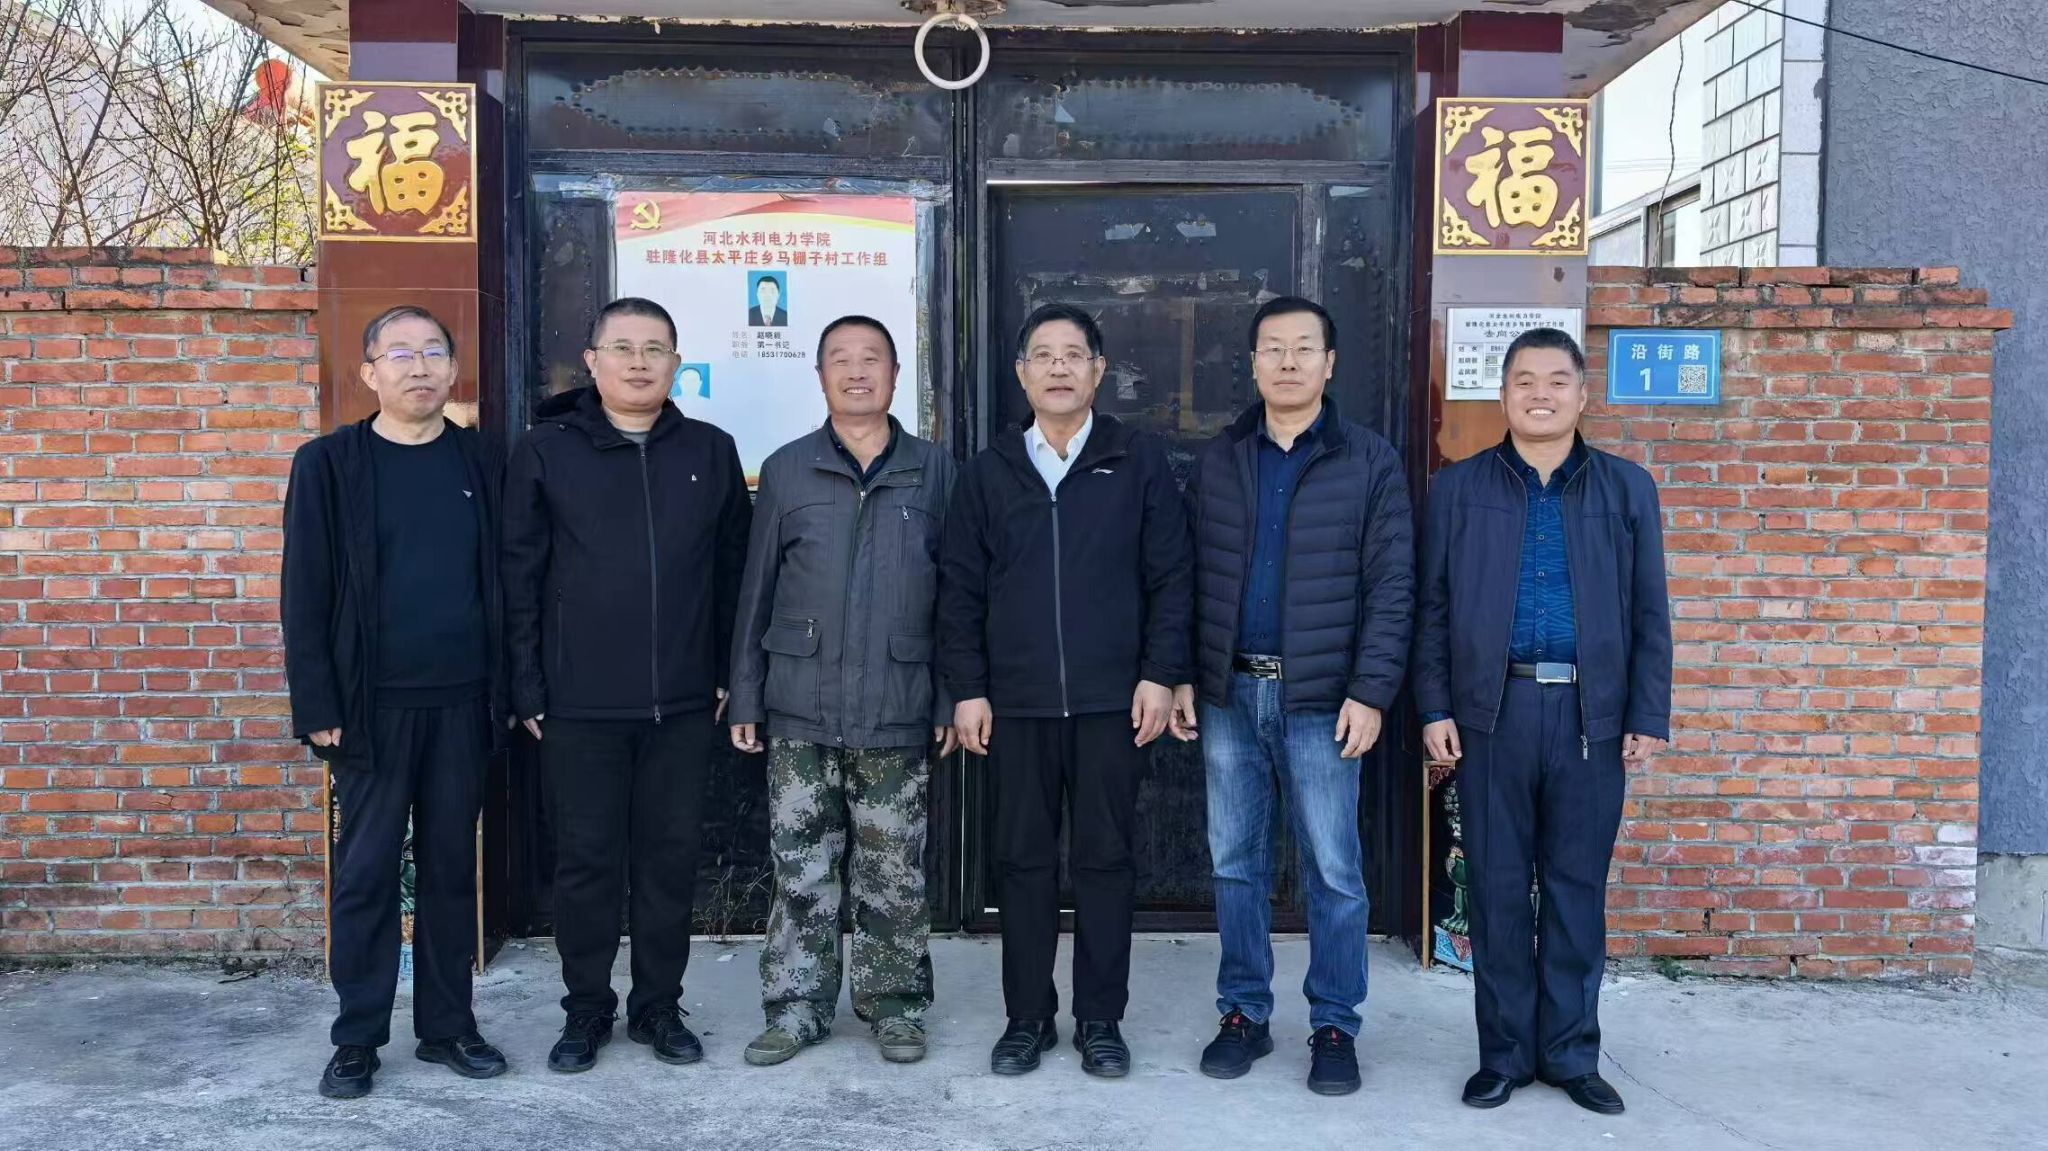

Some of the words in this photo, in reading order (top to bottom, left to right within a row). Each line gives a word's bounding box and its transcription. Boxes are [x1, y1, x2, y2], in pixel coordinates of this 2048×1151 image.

[346, 110, 444, 216] 福
[1464, 126, 1559, 228] 福
[702, 231, 832, 247] 河北水利电力学院
[646, 248, 888, 267] 驻隆化县太平庄乡马棚子村工作组
[1483, 329, 1524, 339] 去向公
[757, 341, 791, 350] 第一书记
[1631, 343, 1701, 361] 沿街路
[1639, 368, 1651, 391] 1
